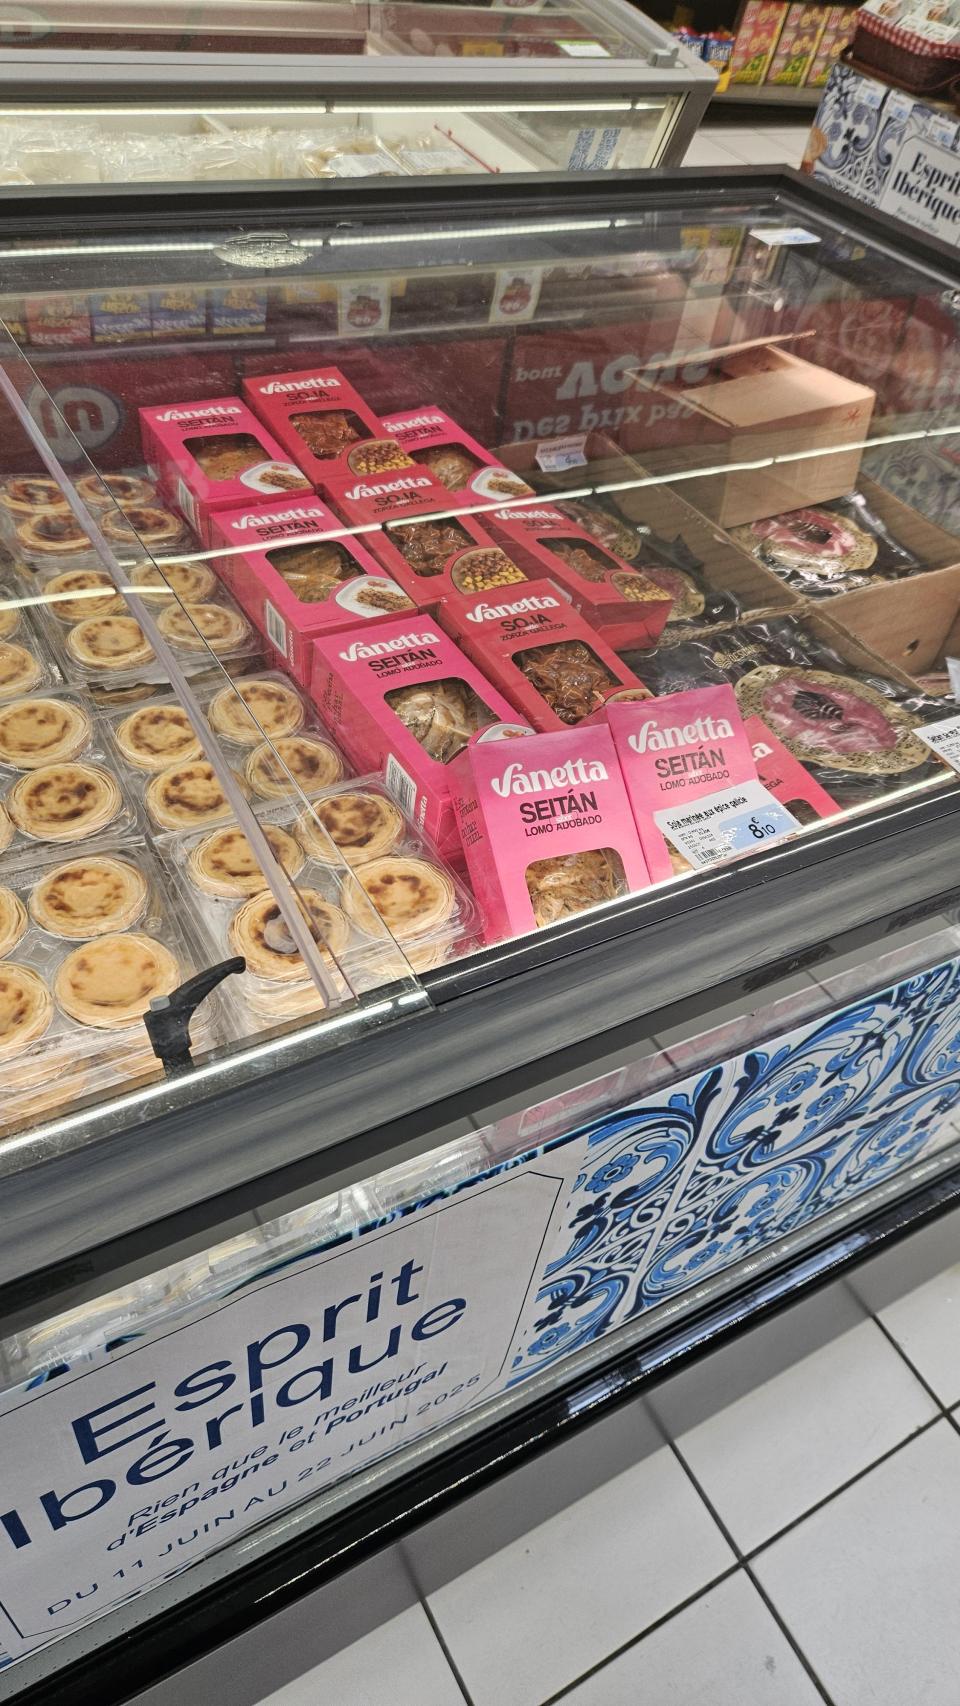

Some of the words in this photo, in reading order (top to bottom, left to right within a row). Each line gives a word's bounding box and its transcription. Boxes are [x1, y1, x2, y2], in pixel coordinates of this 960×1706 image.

[259, 377, 341, 394] Vanetta
[286, 389, 329, 401] SOJA
[156, 406, 242, 422] Vanetta
[177, 415, 235, 428] SEITÁN
[382, 415, 446, 433] anetta
[344, 477, 433, 501] Vanetta
[374, 491, 422, 506] SOJA
[231, 507, 325, 530] Vanetta
[494, 509, 564, 520] Vanetta
[256, 519, 319, 536] SEITÁN
[466, 594, 560, 623] Vanetta
[501, 614, 552, 632] SOJA
[338, 631, 440, 662] Vanetta
[368, 648, 437, 672] SEITÁN
[376, 668, 401, 679] LOMO
[403, 659, 443, 672] ADOBADO
[628, 714, 736, 755] Vanetta
[654, 745, 726, 779] SEITÁN
[490, 756, 609, 798] Vanetta
[660, 779, 686, 791] LOMO
[688, 770, 730, 785] ADOBADO
[519, 788, 598, 823] SEITÁN
[703, 808, 715, 818] aux
[524, 824, 553, 837] LOMO
[556, 815, 602, 831] ADOBADO
[71, 1258, 424, 1465] Esprit
[0, 1298, 467, 1549] Ibérique
[128, 1482, 201, 1527] Rien
[211, 1444, 268, 1482] que
[279, 1425, 304, 1446] le
[313, 1361, 428, 1425] meilleur
[106, 1452, 279, 1551] d'Espagne
[288, 1430, 316, 1452] et
[325, 1361, 448, 1435] Portugal
[47, 1583, 98, 1615] DU
[112, 1560, 144, 1579] 11
[158, 1507, 236, 1557] JUIN
[243, 1480, 289, 1511] AU
[298, 1455, 332, 1482] 22
[341, 1415, 408, 1458] JUIN
[416, 1373, 481, 1415] 2025
